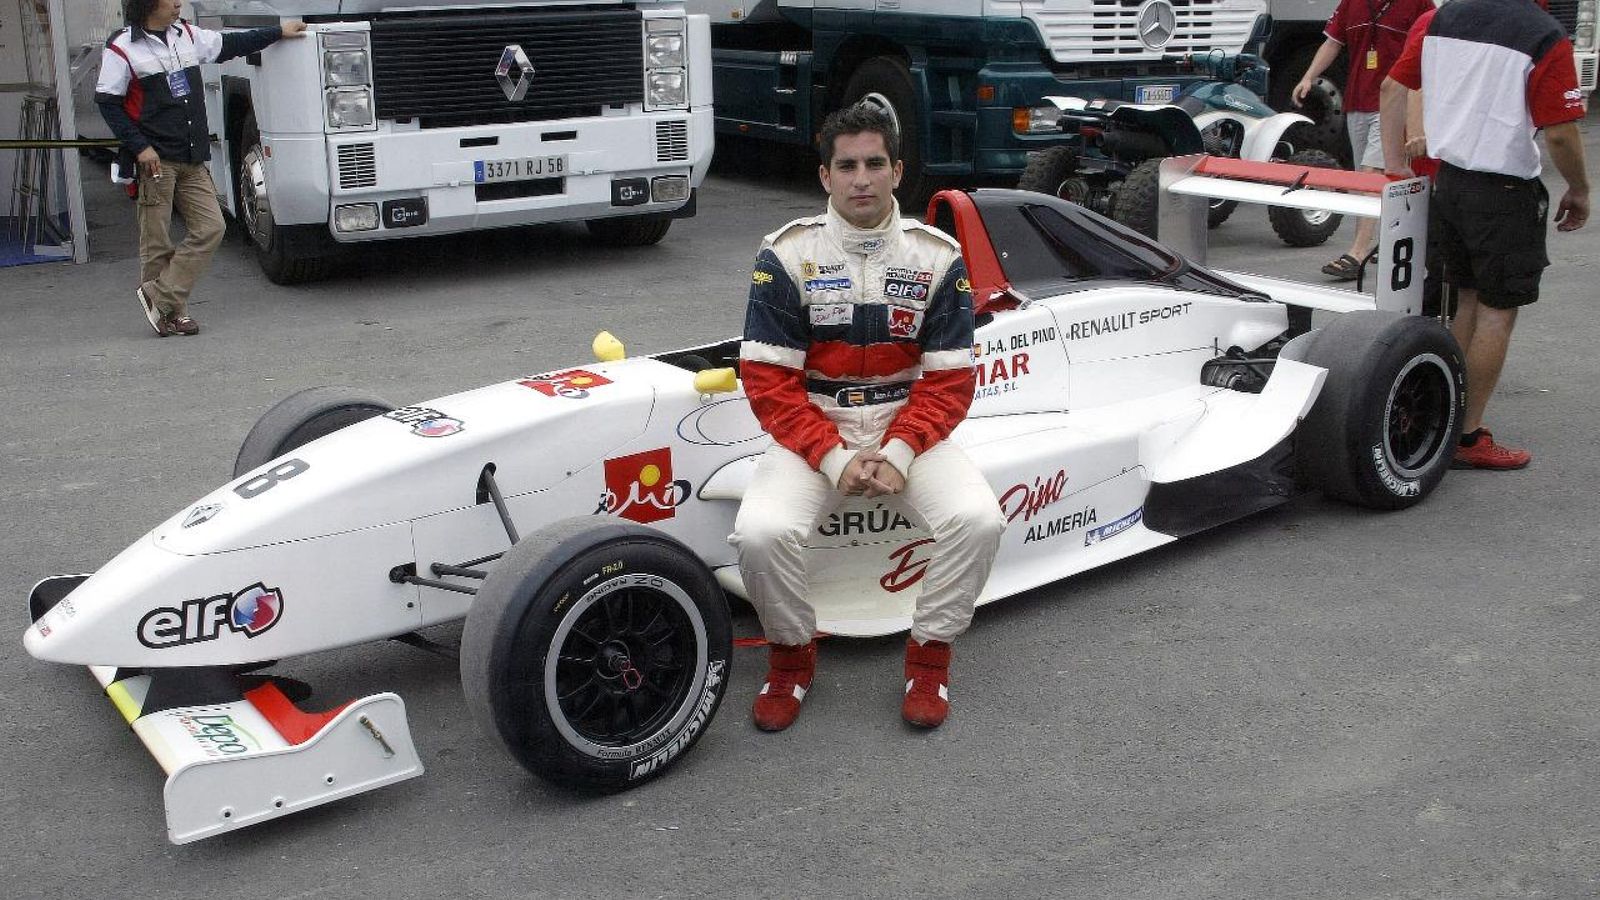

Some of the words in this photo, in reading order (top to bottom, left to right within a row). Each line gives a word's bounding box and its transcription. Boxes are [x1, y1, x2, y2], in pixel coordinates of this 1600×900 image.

[487, 161, 519, 177] 3371
[526, 160, 542, 175] RJ
[548, 158, 563, 173] 58
[1391, 237, 1413, 291] 8
[886, 283, 914, 297] elf
[1070, 312, 1136, 340] RENAULT
[1139, 302, 1192, 324] SPORT
[985, 341, 1007, 356] J-A.
[1010, 333, 1030, 350] DEL
[1032, 326, 1056, 346] PINO
[233, 458, 311, 500] 8
[818, 503, 918, 536] GRÚA
[1024, 505, 1097, 544] ALMERÍA
[137, 592, 234, 649] elf
[632, 690, 717, 779] MICHELIN
[635, 729, 672, 755] RENAULT
